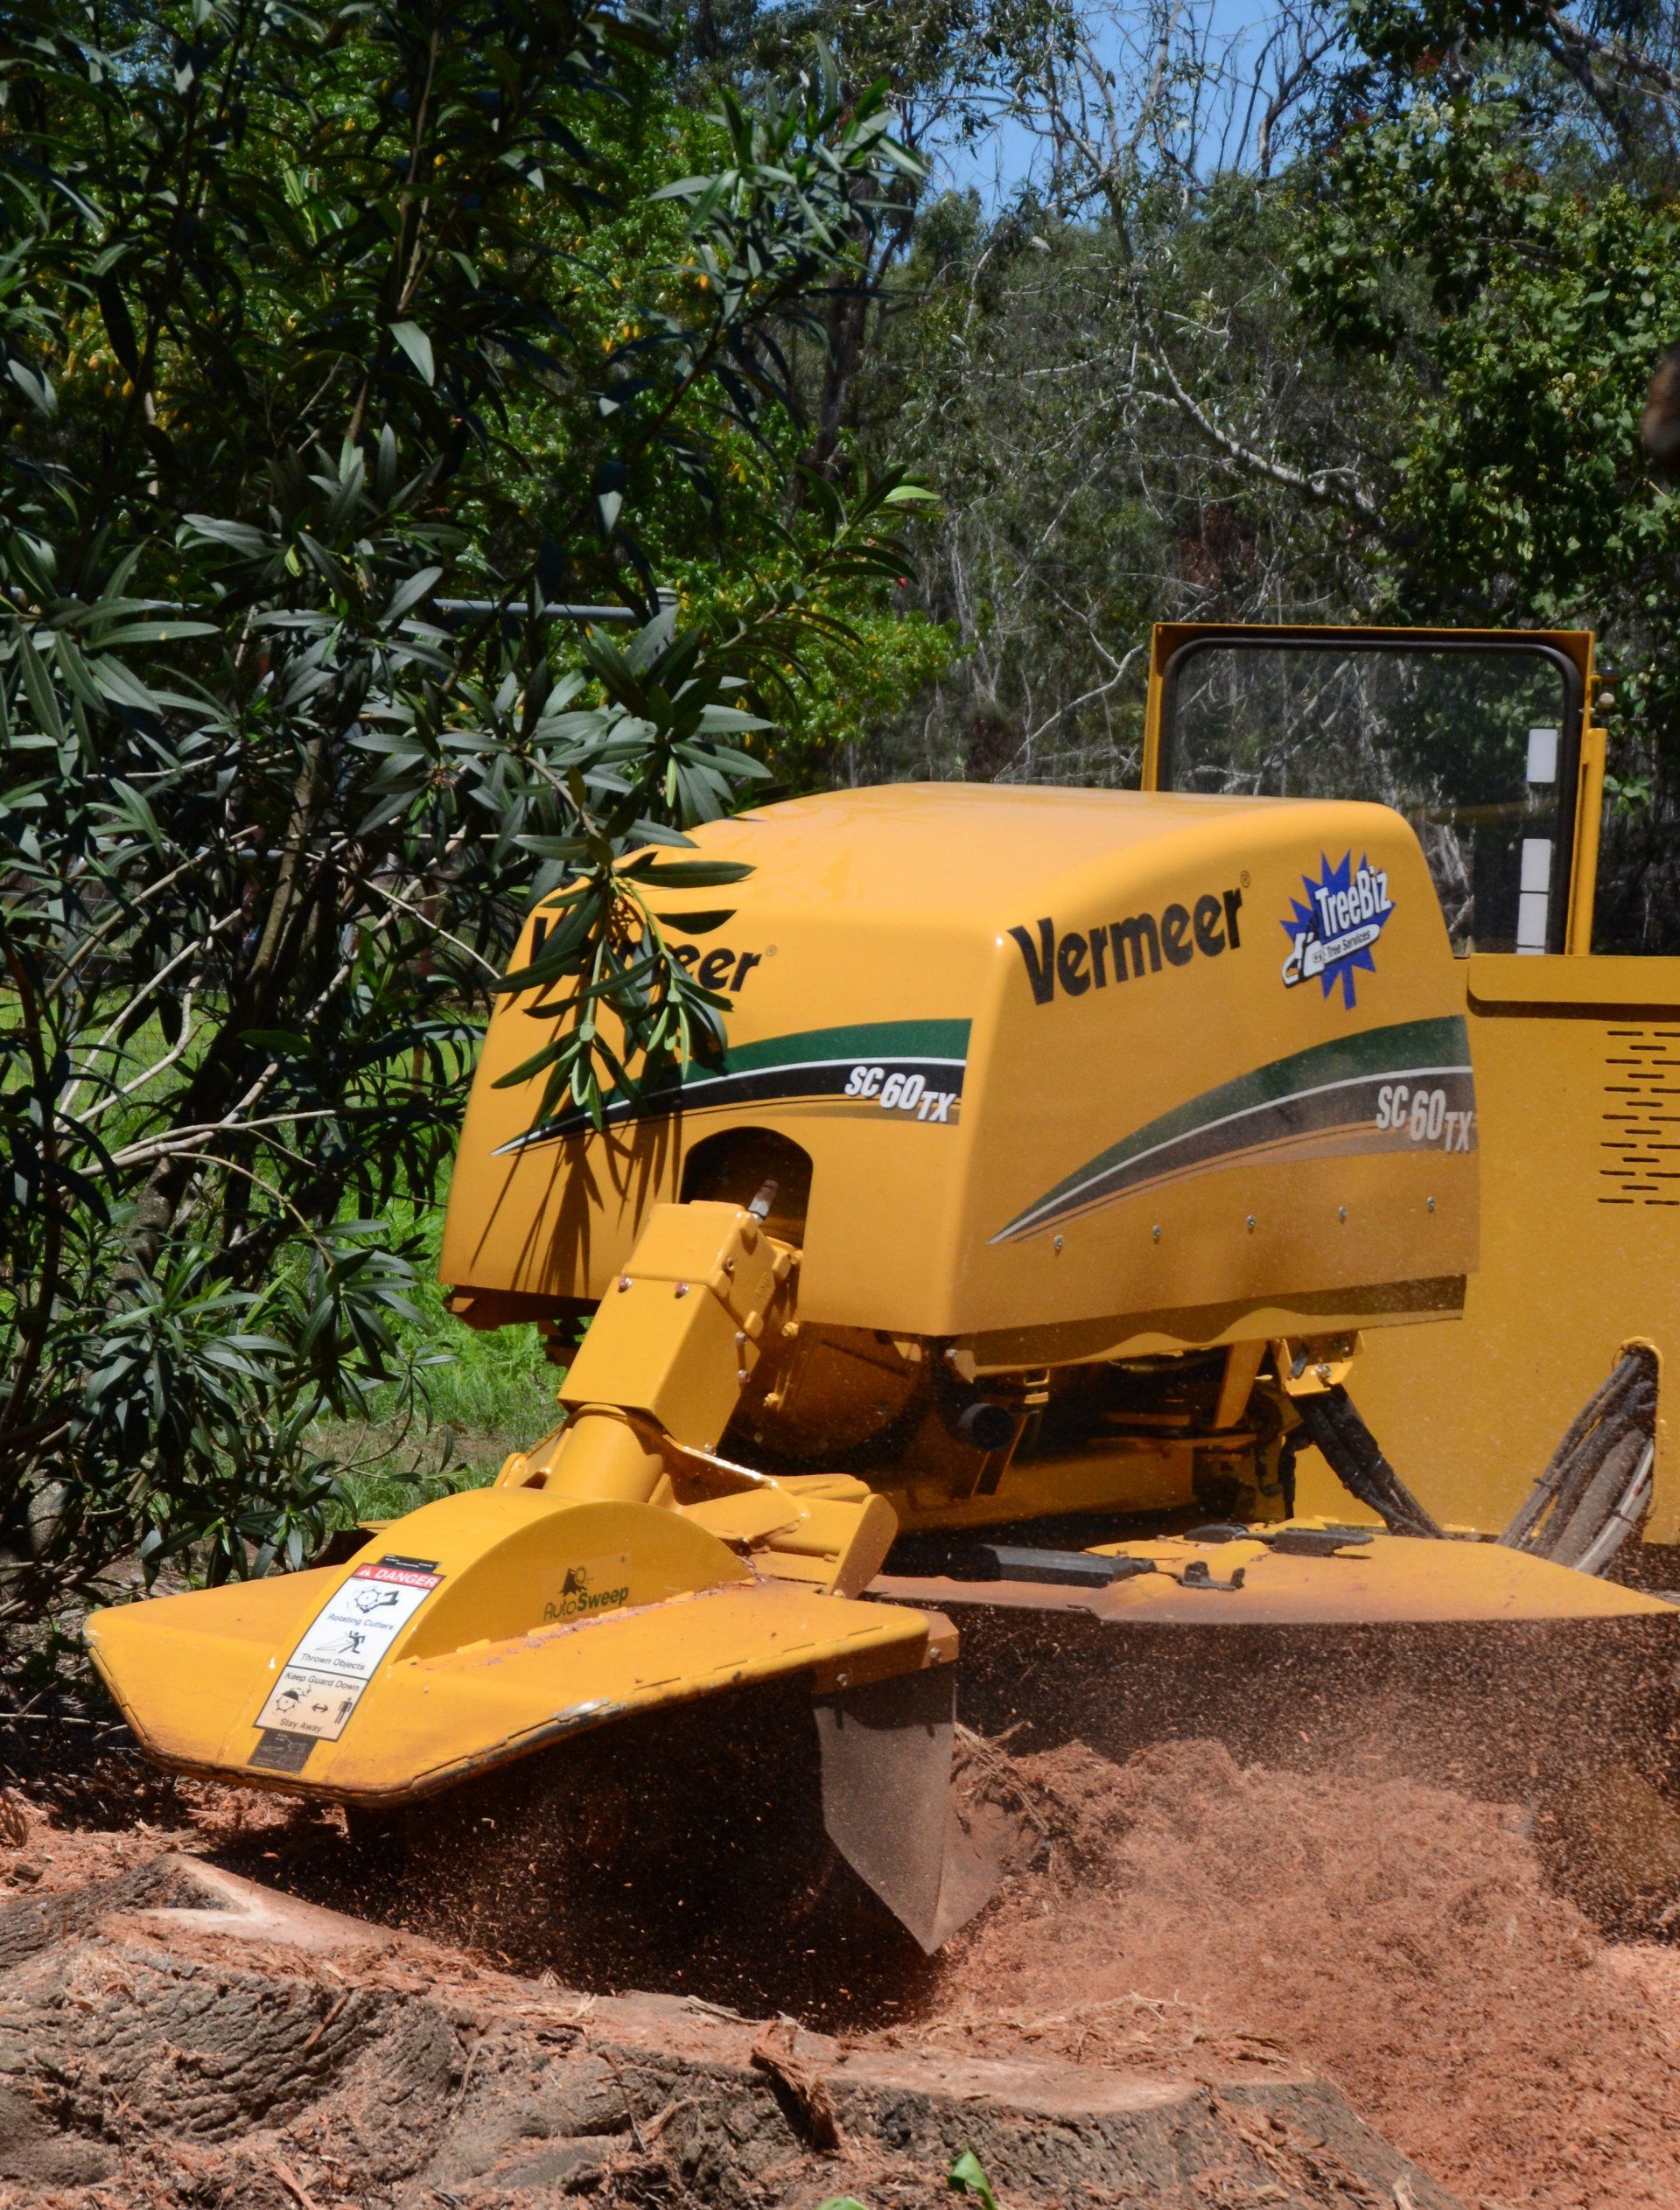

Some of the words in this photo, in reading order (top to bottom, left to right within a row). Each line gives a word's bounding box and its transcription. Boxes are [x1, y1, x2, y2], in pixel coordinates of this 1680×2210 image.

[1314, 865, 1392, 938] TreeBiz
[1007, 887, 1242, 1005] Vermeer
[1326, 945, 1341, 957] Tree
[1342, 929, 1371, 951] Services
[374, 1569, 438, 1589] DANGER
[543, 1586, 629, 1620] AutoSweep
[327, 1613, 362, 1626] Rotating
[363, 1619, 394, 1631] Cutters
[301, 1653, 332, 1664] Thrown
[332, 1658, 366, 1671] Objects
[285, 1671, 306, 1682] Keep
[308, 1675, 334, 1687] Guard
[335, 1679, 360, 1692] Down
[280, 1717, 298, 1730] Stay
[298, 1721, 324, 1733] Away
